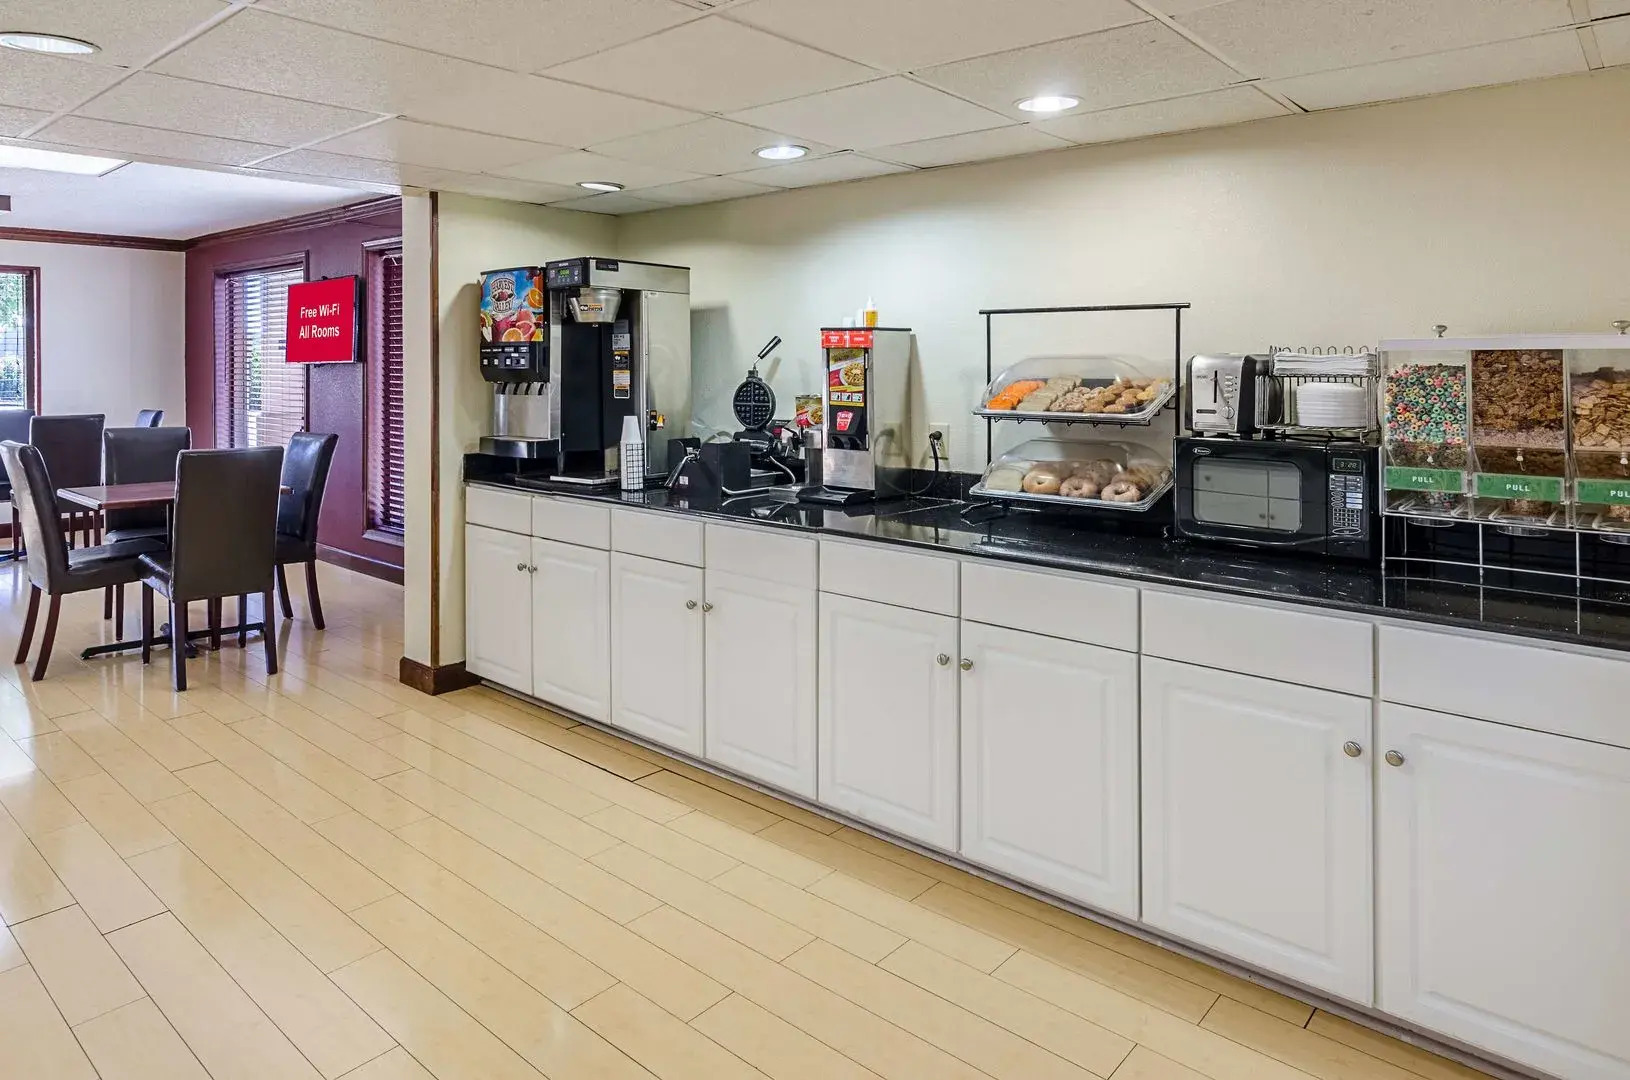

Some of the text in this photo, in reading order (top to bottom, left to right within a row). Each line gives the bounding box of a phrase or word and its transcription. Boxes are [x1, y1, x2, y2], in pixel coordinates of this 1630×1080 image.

[300, 303, 340, 319] Free Wi-Fi
[299, 325, 340, 339] All Rooms
[1506, 483, 1531, 492] PULL
